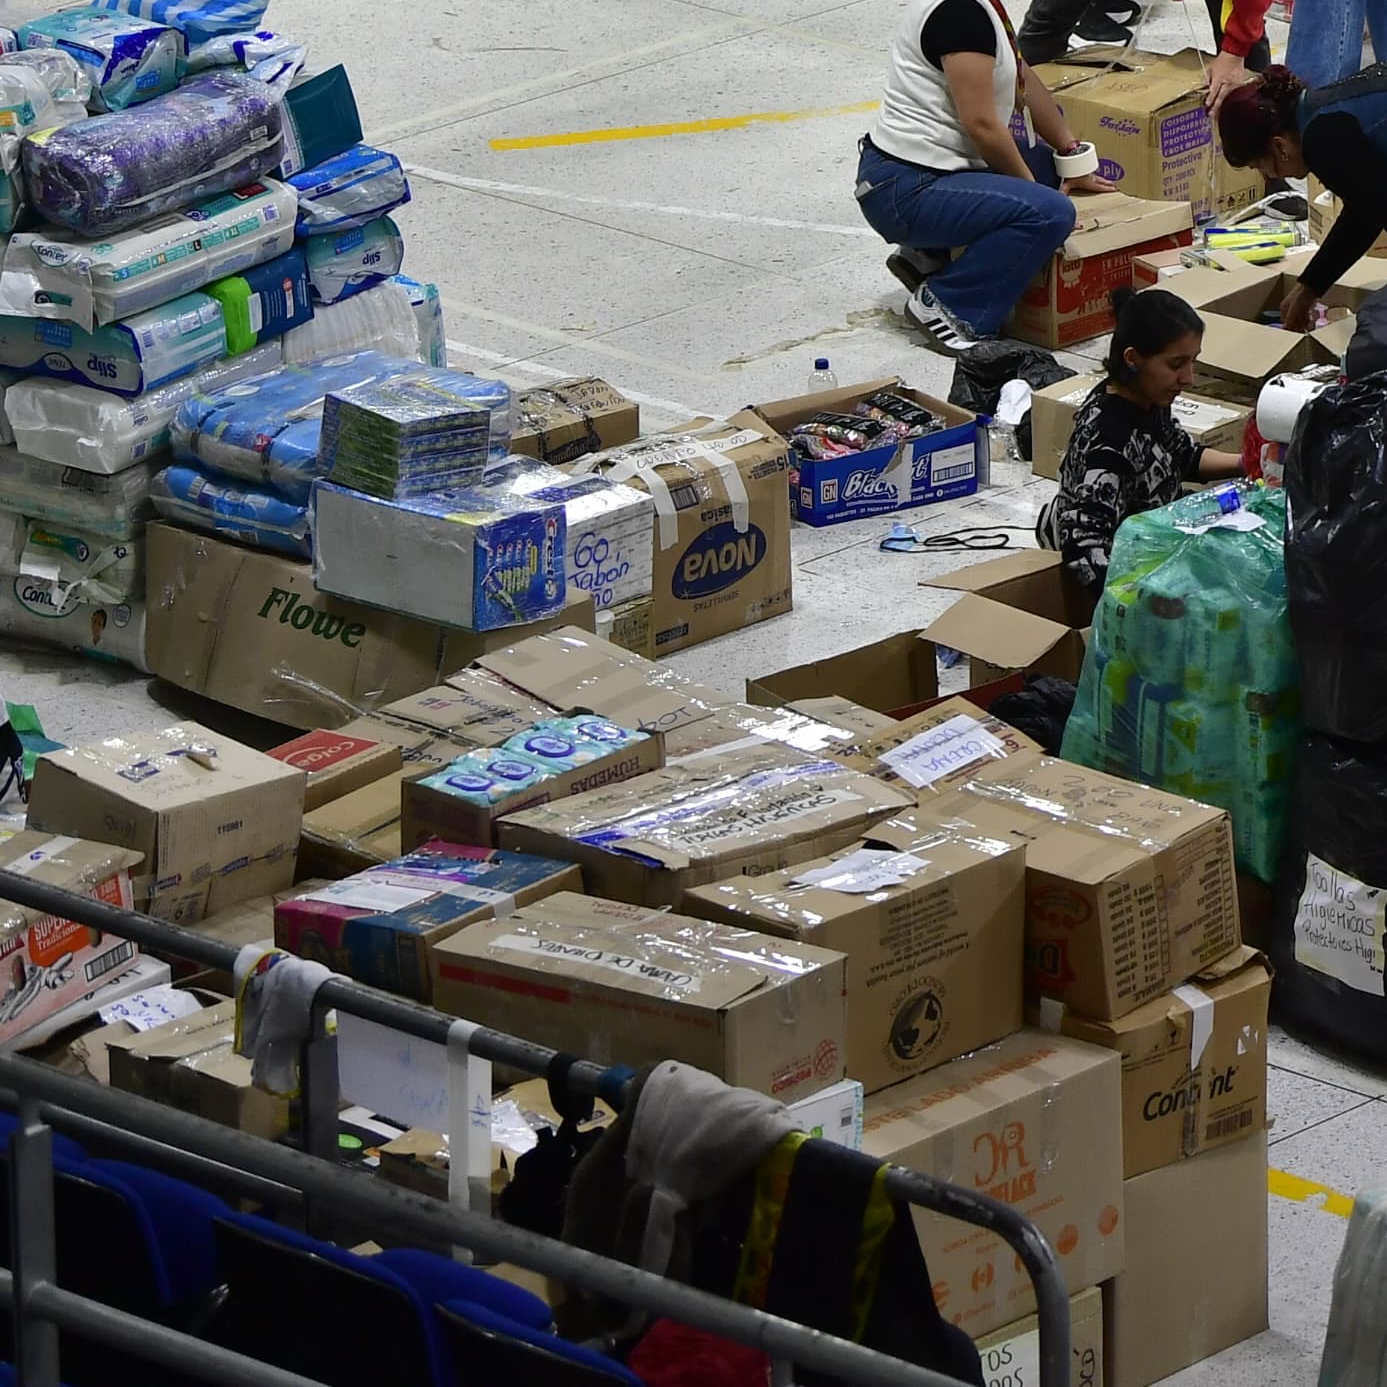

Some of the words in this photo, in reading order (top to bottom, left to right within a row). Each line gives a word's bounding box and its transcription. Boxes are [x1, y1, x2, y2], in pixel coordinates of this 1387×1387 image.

[1104, 164, 1121, 179] ply
[363, 251, 381, 266] Slip
[87, 356, 118, 380] Slip
[823, 481, 836, 502] GN
[573, 531, 610, 566] 60
